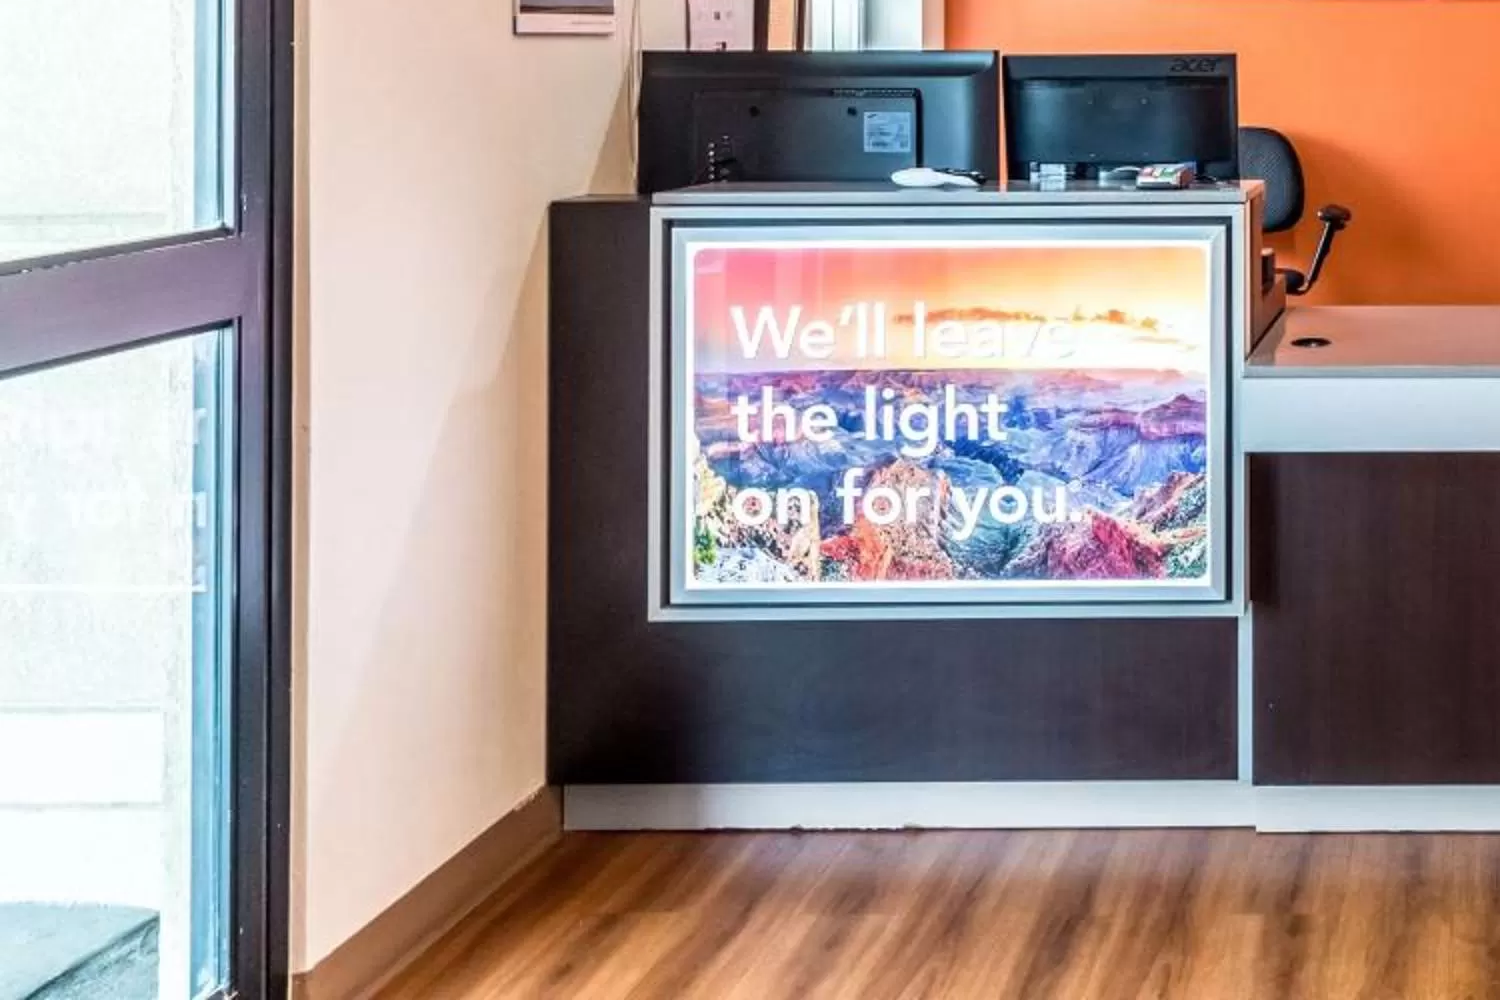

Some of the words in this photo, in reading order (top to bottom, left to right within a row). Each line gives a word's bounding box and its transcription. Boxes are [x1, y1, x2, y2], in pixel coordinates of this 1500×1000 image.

[1170, 57, 1222, 73] acer
[730, 301, 886, 360] We'll
[913, 300, 1080, 360] leave
[730, 385, 838, 442] the
[865, 383, 1008, 458] light
[732, 485, 812, 526] on
[836, 467, 930, 526] for
